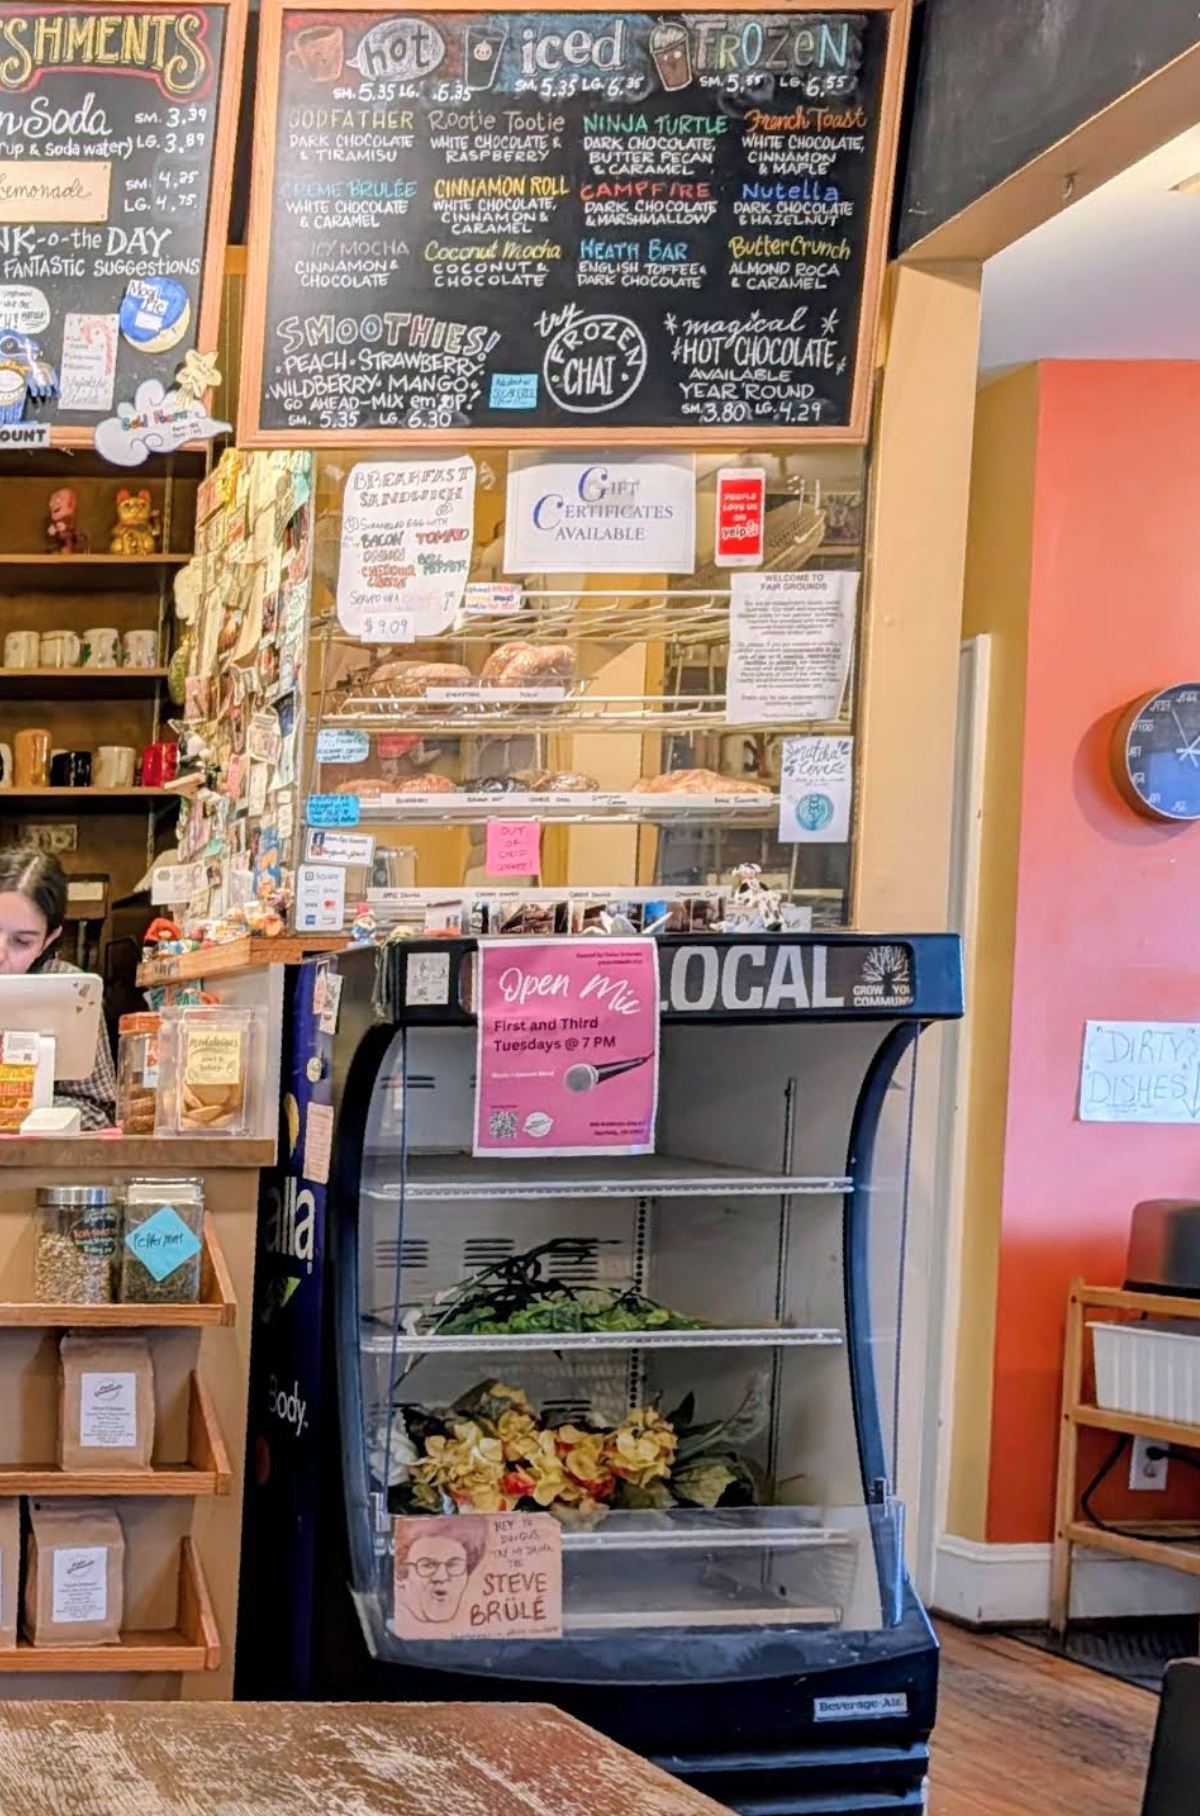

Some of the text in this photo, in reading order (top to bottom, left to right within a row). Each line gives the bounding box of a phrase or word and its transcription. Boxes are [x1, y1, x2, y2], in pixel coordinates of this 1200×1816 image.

[363, 18, 627, 79] hot iced
[357, 83, 396, 101] 5.35
[540, 78, 577, 98] 5.35
[23, 92, 113, 139] Soda
[428, 109, 566, 133] Rootie Tootie
[582, 112, 728, 135] NINJA TURTLE
[44, 137, 81, 156] soda
[288, 133, 415, 148] DARK CHOCOLATE
[316, 149, 398, 162] TIRAMISU
[446, 150, 551, 164] RASPBERRY
[589, 151, 714, 165] BUTTER PECAN
[747, 152, 836, 165] CINNAMON
[772, 163, 829, 175] MAPLE
[434, 175, 571, 198] CINNAMON ROLL
[580, 181, 711, 200] CAMPFIRE
[742, 181, 839, 201] Nutella
[584, 201, 718, 214] DARK CHOCOLATE
[313, 214, 381, 230] CARAMEL
[750, 214, 838, 227] HAZELNUT
[106, 227, 173, 258] DAY
[424, 240, 496, 261] Coconut
[580, 238, 688, 261] HEATH BAR
[433, 261, 532, 274] COCONUT
[579, 261, 699, 275] ENGLISH TOFFEE
[729, 262, 840, 277] ALMOND ROCA
[301, 273, 391, 288] CHOCOLATE
[434, 273, 546, 287] CHOCOLATE
[746, 277, 827, 290] CARAMEL
[549, 321, 642, 367] FROZEN
[681, 336, 838, 368] HOT CHOCOLATE
[285, 347, 479, 377] PEACH STRAWBERRY
[563, 355, 617, 396] CHAI
[688, 368, 792, 383] AVAILABLE
[269, 373, 379, 399] WILDBERRY
[387, 373, 469, 392] MANGO
[678, 382, 735, 400] YEAR
[353, 466, 474, 491] BREAKFAST
[359, 486, 464, 508] SANDWICH
[555, 527, 646, 541] AVAILABLE
[666, 944, 845, 1011] OCAL
[499, 966, 642, 1016] Open Mic
[494, 1016, 599, 1032] First and Third
[493, 1036, 616, 1056] Tuesdays PM
[483, 1571, 548, 1596] STEVE
